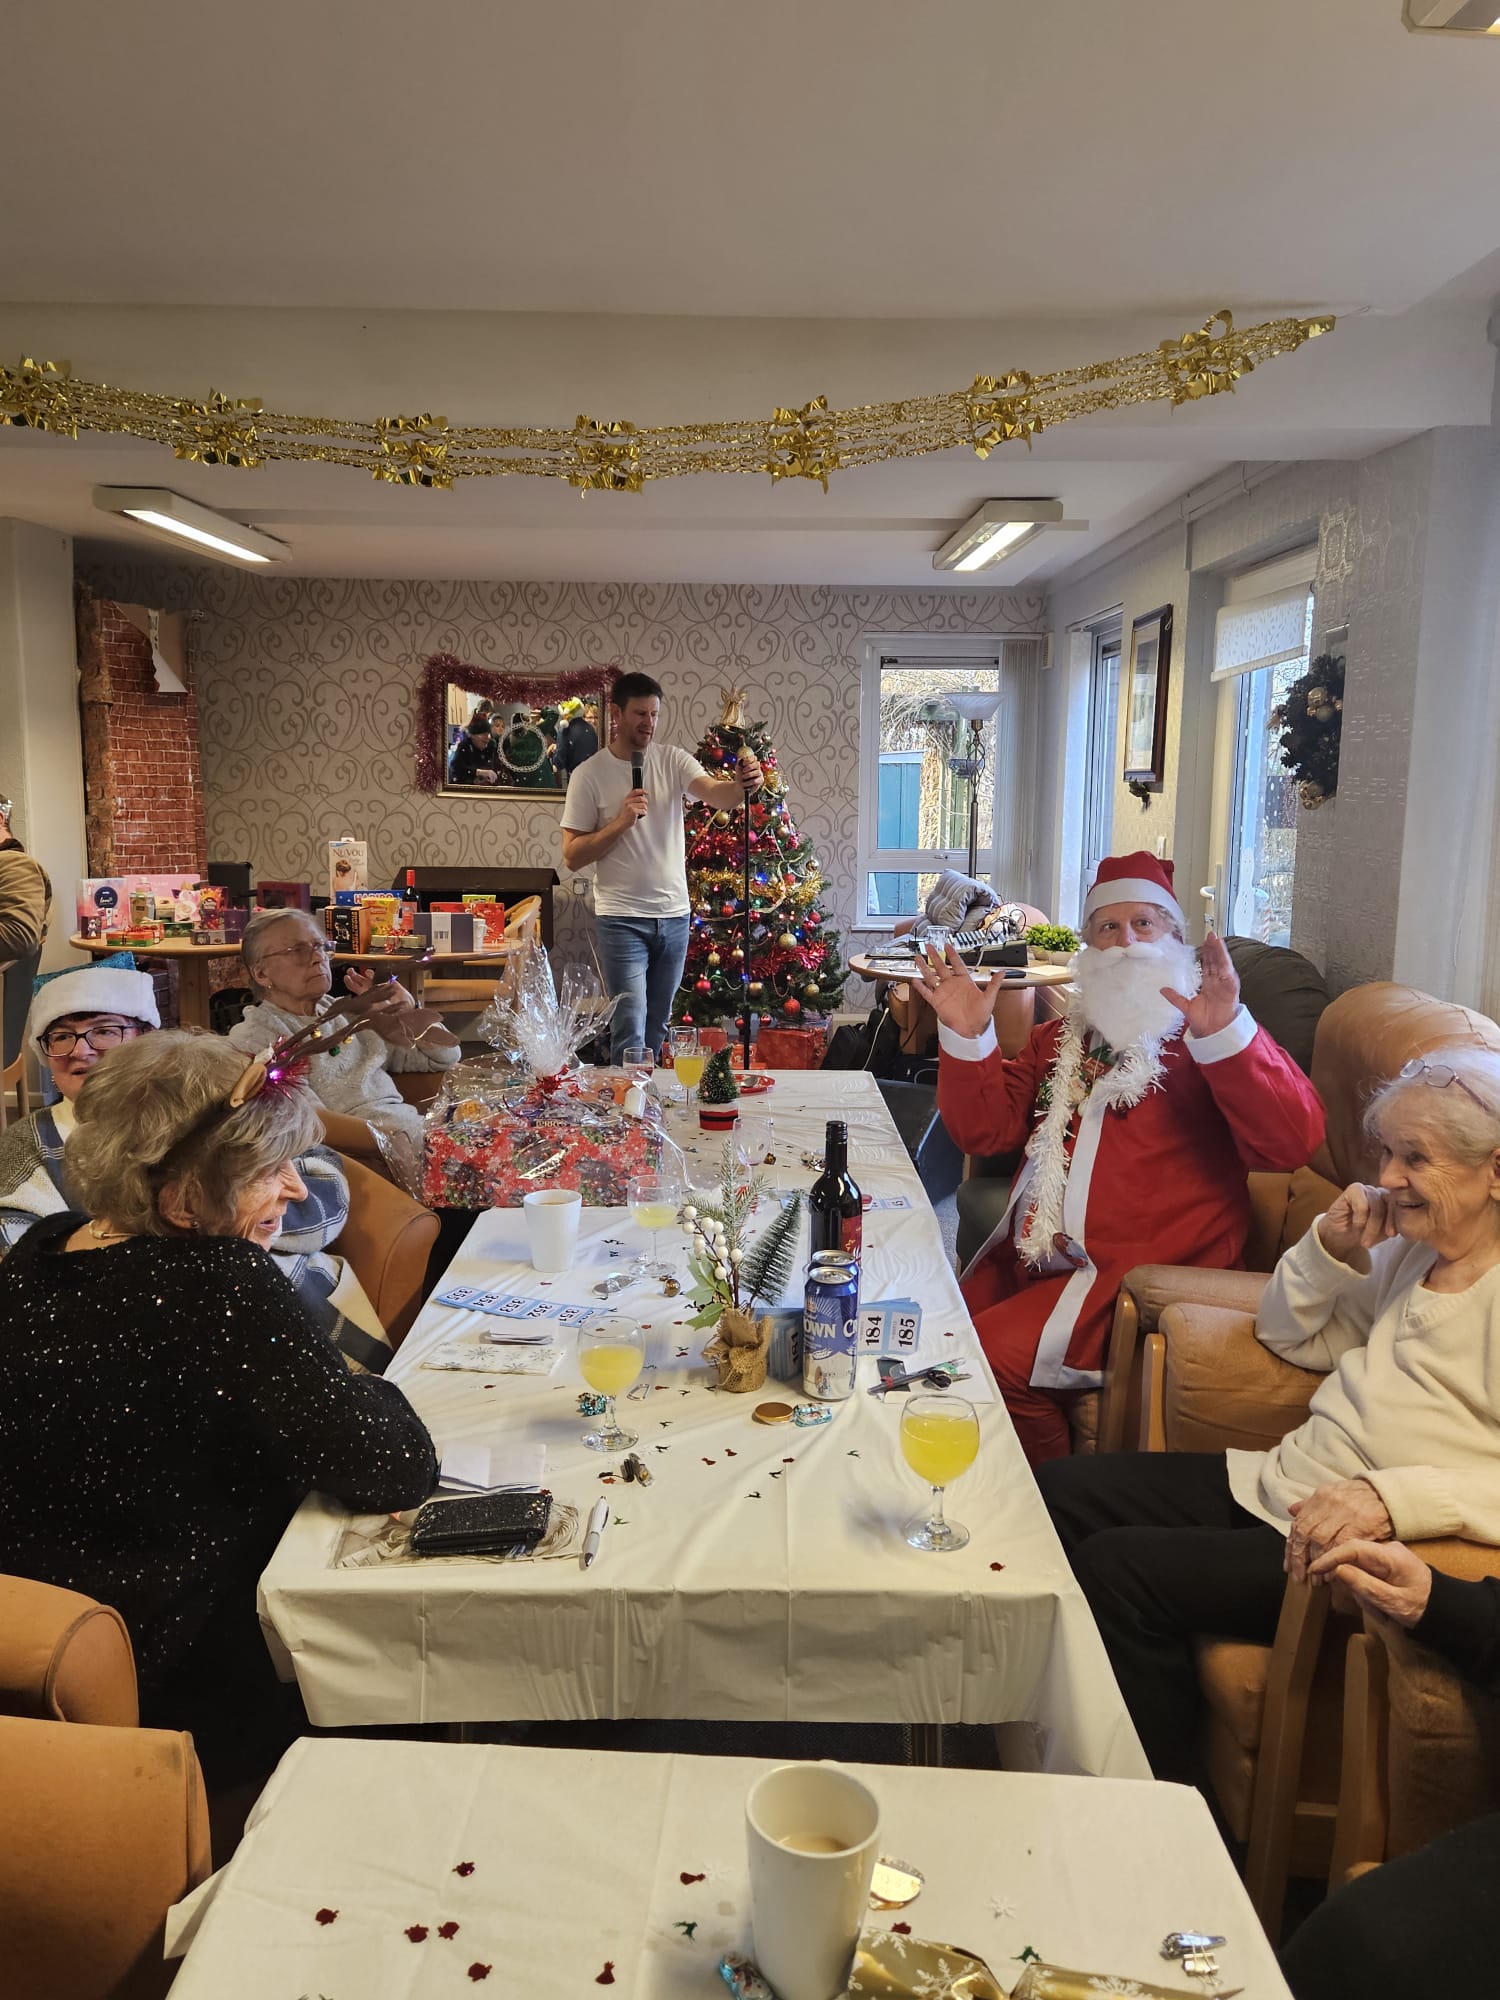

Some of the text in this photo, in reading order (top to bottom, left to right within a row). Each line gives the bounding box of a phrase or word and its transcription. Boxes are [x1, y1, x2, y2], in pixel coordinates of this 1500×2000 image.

[499, 1298, 526, 1313] 353
[526, 1303, 553, 1318] 352
[865, 1316, 882, 1346] 184
[898, 1318, 916, 1348] 185
